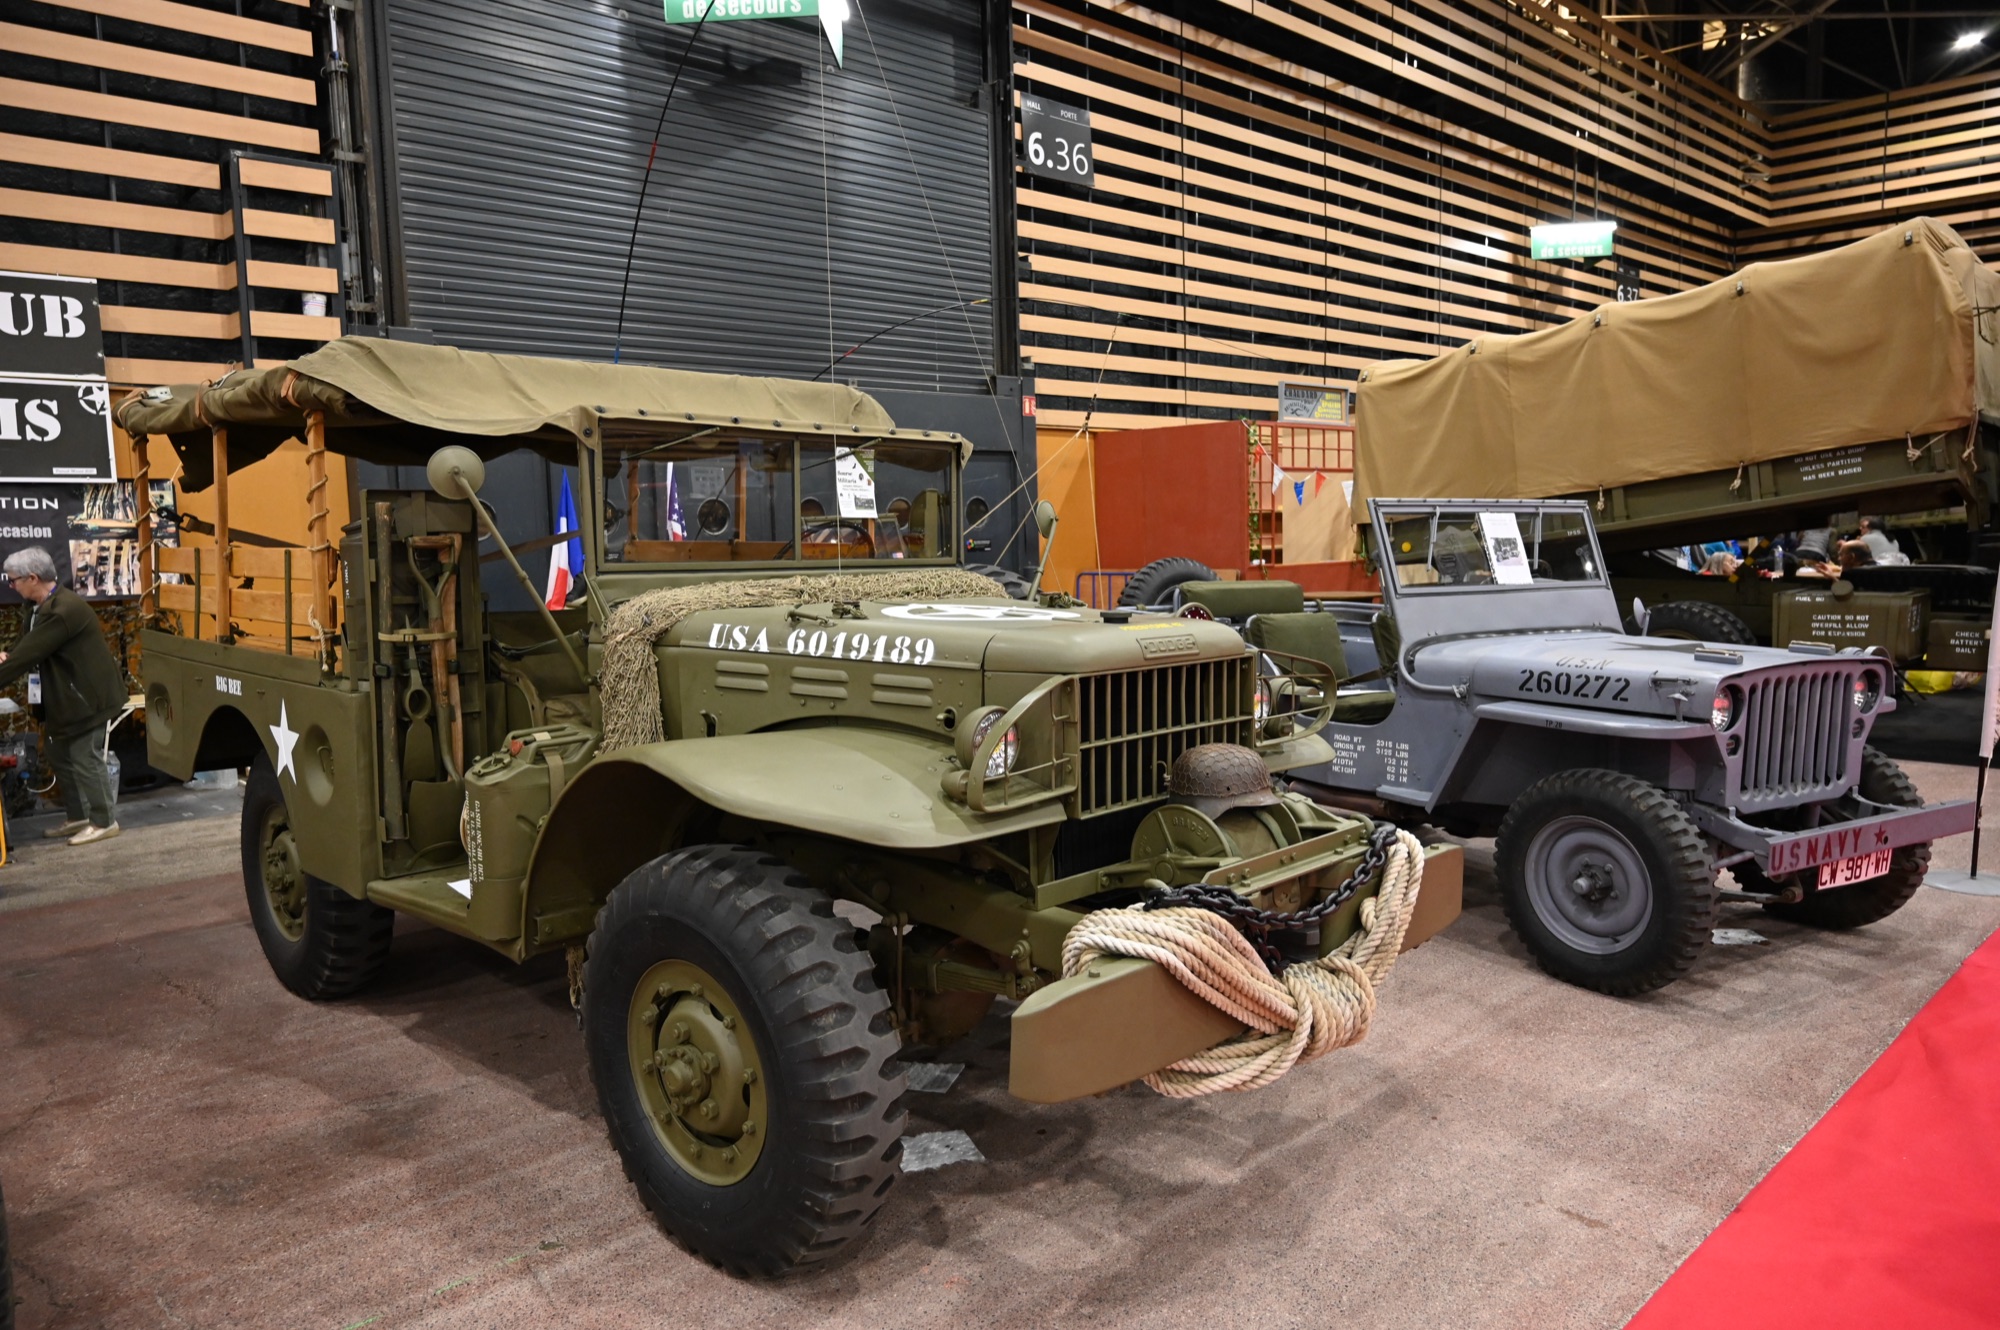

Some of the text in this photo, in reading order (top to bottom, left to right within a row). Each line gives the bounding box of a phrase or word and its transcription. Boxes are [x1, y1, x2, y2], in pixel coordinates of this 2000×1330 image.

[714, 0, 802, 16] secours
[1026, 100, 1041, 110] HALL
[1060, 110, 1077, 121] PORTE
[1028, 132, 1088, 175] 6.36
[1541, 244, 1604, 257] de secours
[0, 525, 52, 538] casion
[708, 623, 935, 665] USA 6019189
[216, 675, 242, 696] BIG BEE
[1519, 669, 1630, 702] 260272
[1334, 734, 1350, 742] ROAD
[1396, 742, 1409, 750] LBS
[1334, 742, 1354, 750] GROSS
[1396, 750, 1408, 758] LBS
[1332, 765, 1356, 774] HEIGHT
[1806, 827, 1862, 866] NAVY
